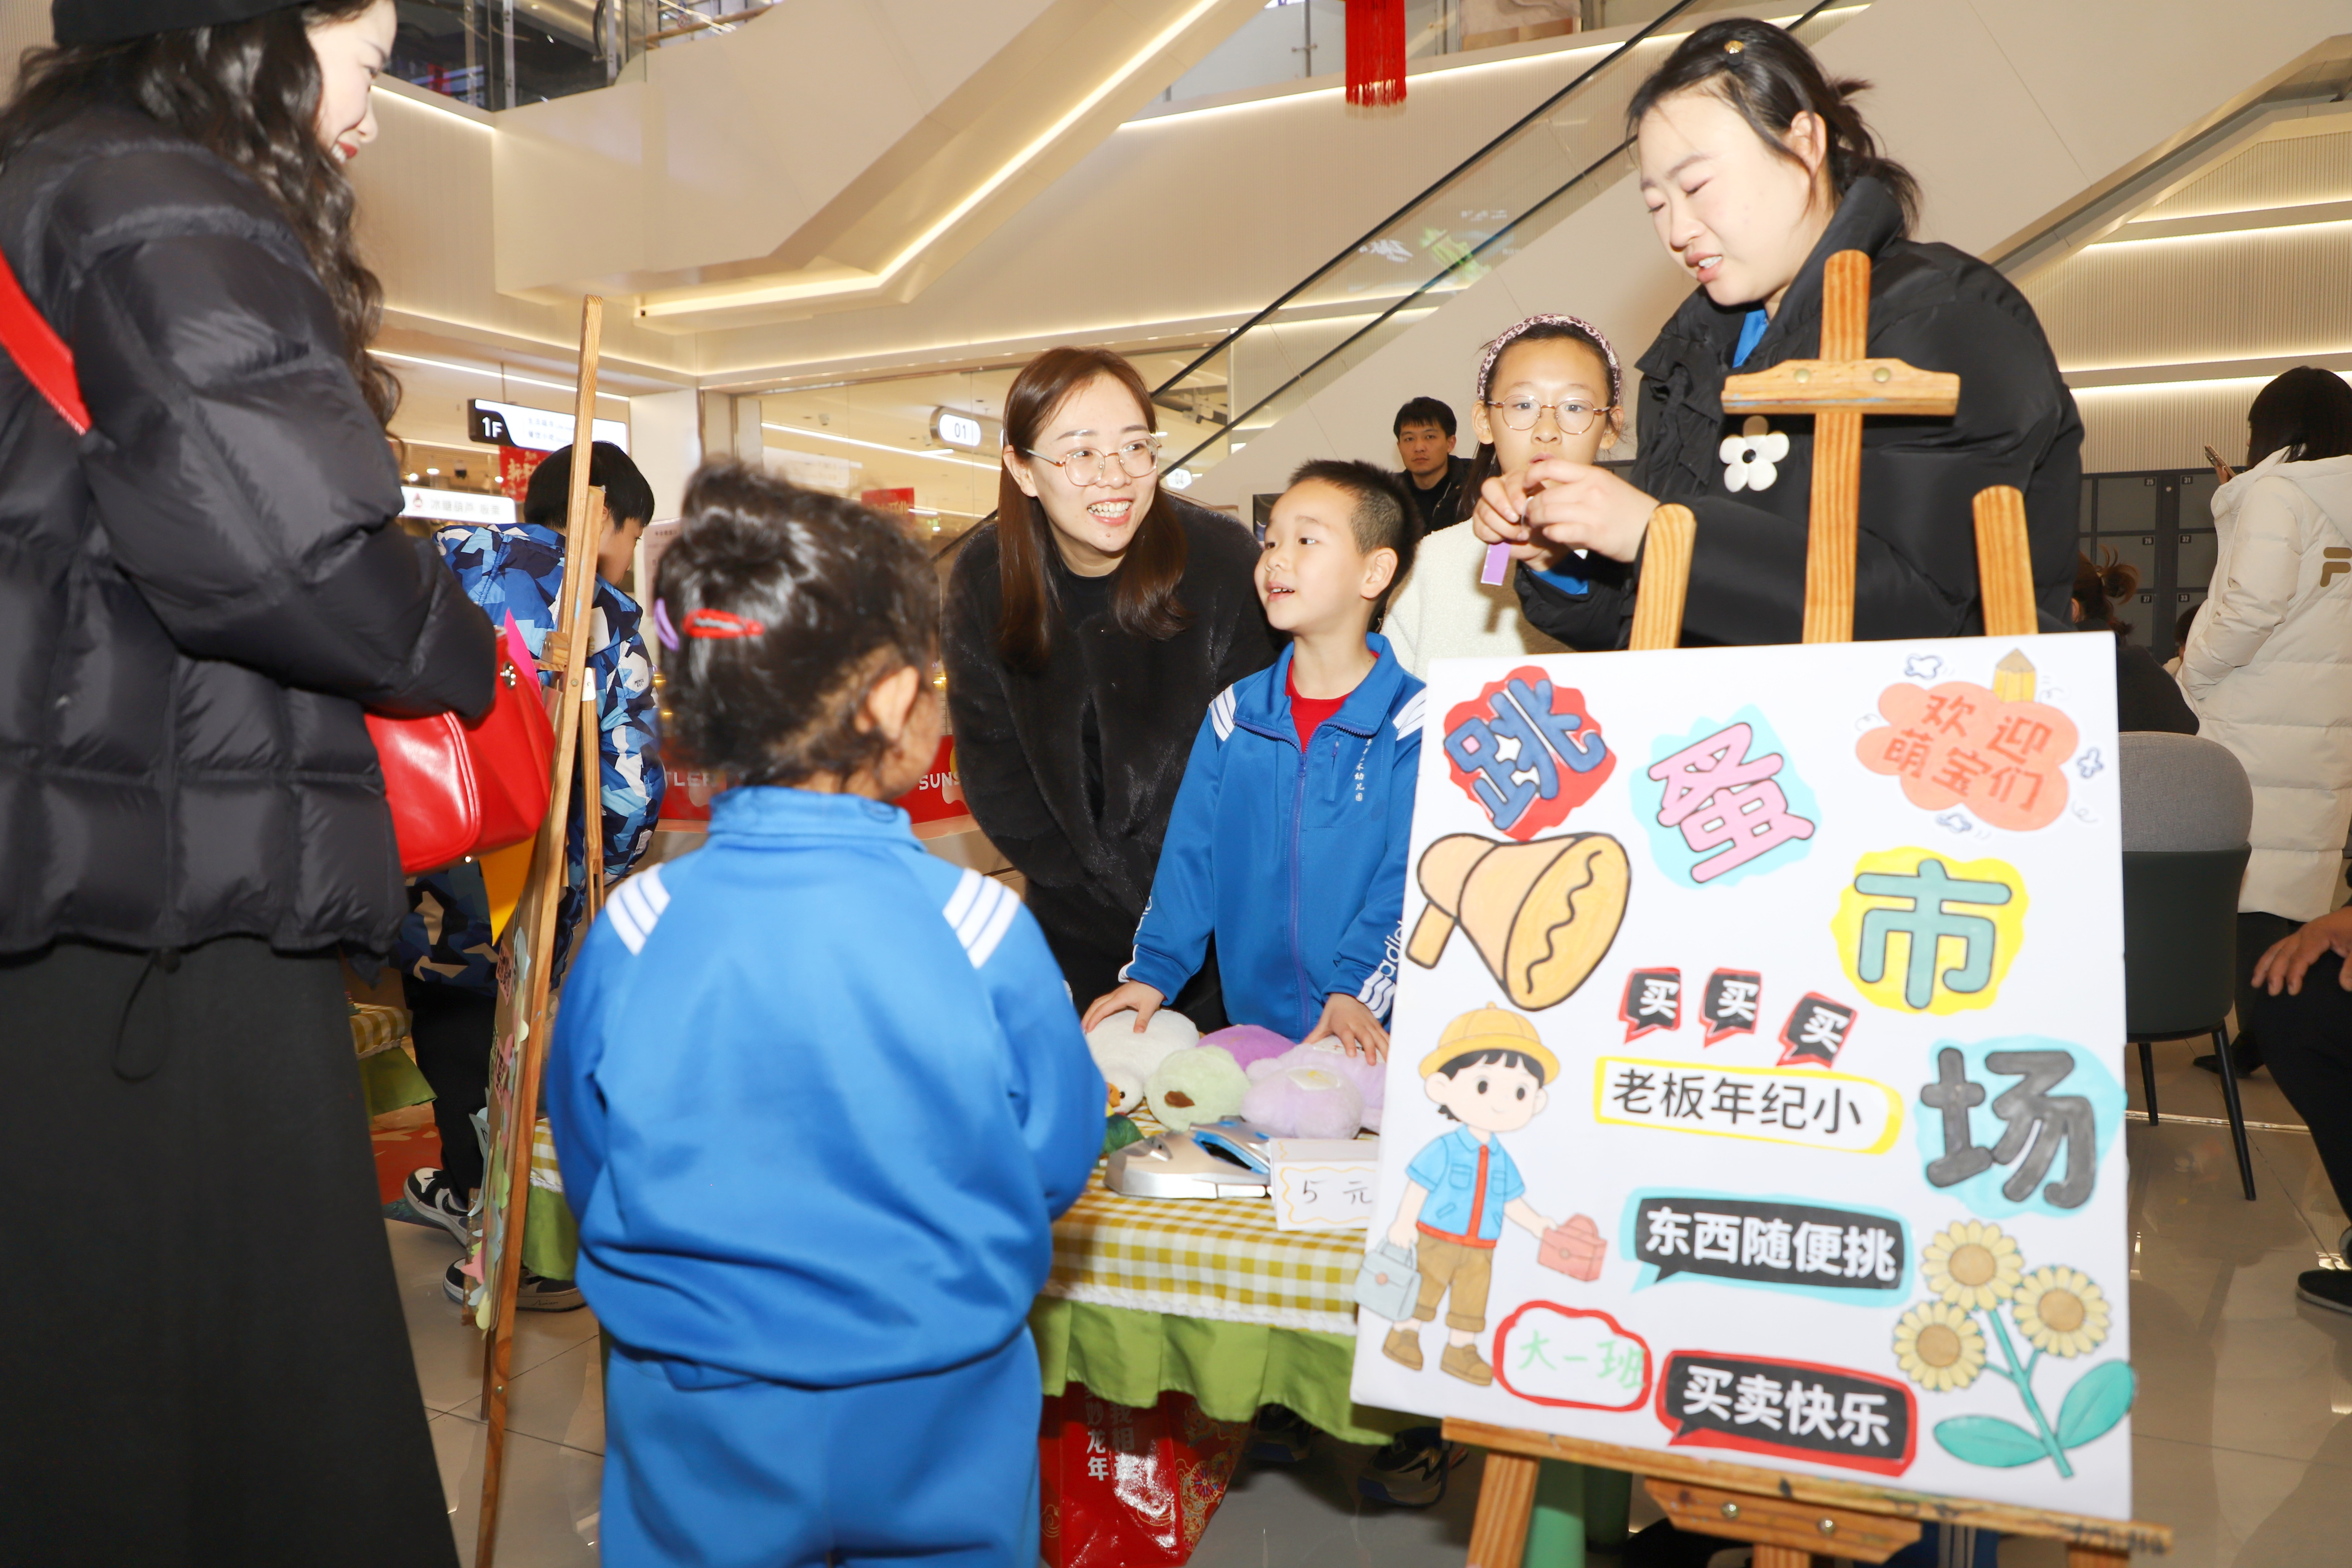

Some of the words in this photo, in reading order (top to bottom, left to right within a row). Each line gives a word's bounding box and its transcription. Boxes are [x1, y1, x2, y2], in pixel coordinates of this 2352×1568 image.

[481, 416, 502, 438] 1F
[955, 423, 966, 439] 01
[1444, 678, 1606, 830] 跳
[1883, 728, 2043, 813] 萌宝们
[1854, 858, 2012, 1009] 市
[1639, 978, 1680, 1020] 买
[1717, 979, 1760, 1021] 买
[1800, 1006, 1851, 1053] 买
[1613, 1069, 1861, 1133] 老板年纪小
[1921, 1048, 2095, 1208] 场
[1646, 1206, 1897, 1281] 东西随便挑
[1519, 1329, 1645, 1389] 大一班
[1683, 1365, 1891, 1447] 买卖快乐
